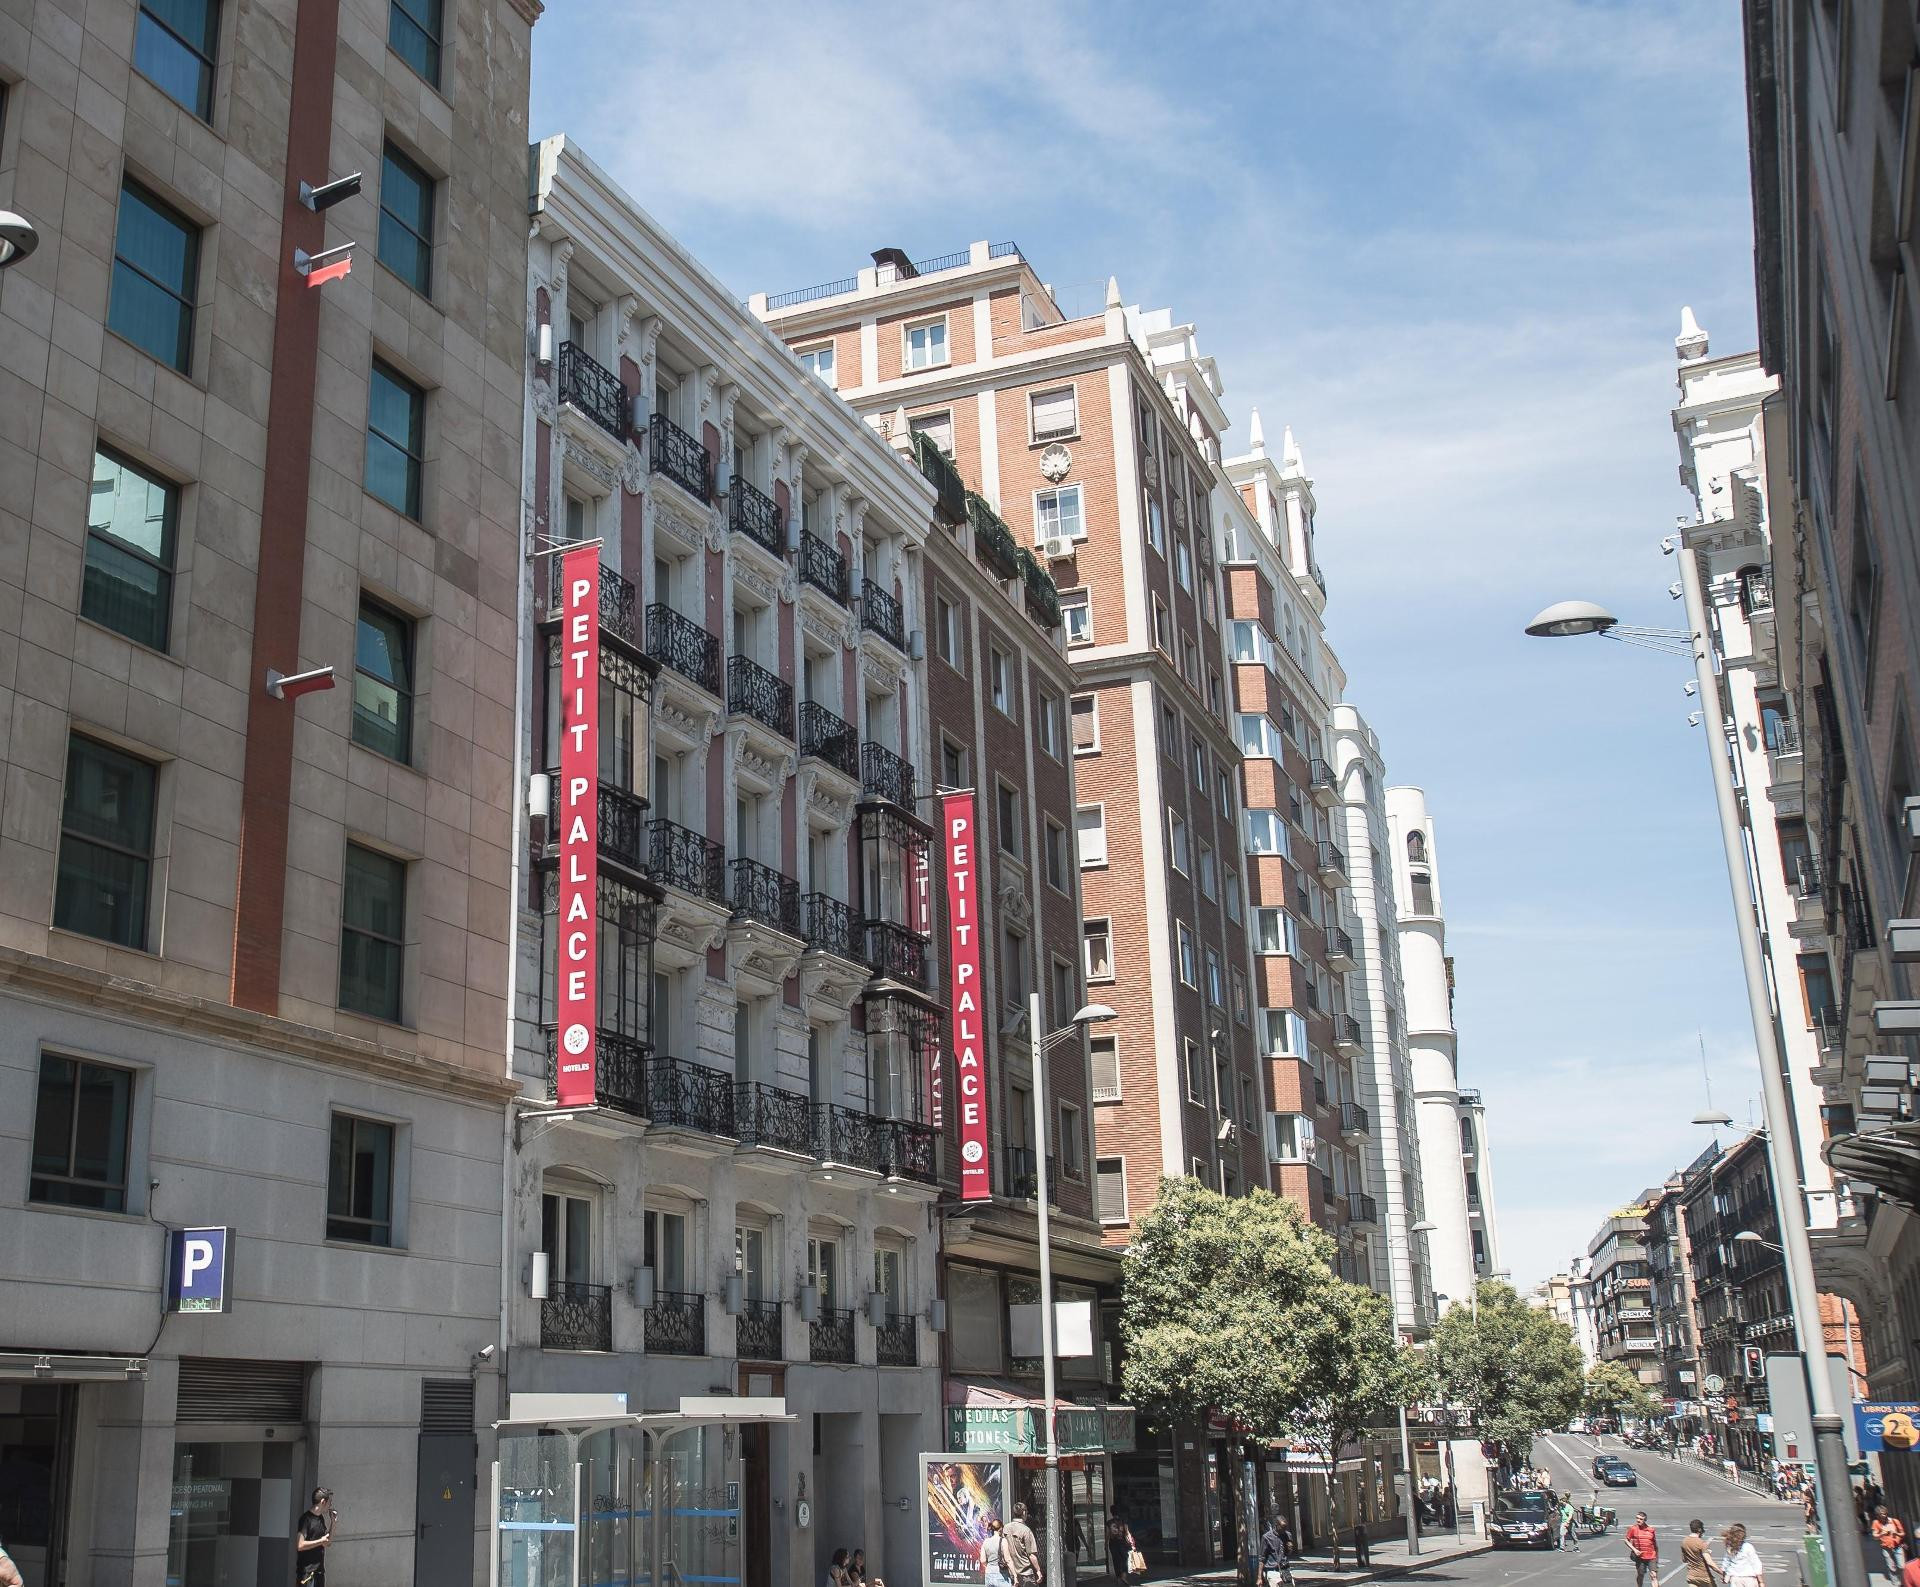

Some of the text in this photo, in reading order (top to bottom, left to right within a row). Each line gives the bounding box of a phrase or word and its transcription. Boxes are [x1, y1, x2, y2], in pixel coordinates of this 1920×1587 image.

[571, 579, 591, 753] PETIT
[567, 777, 589, 1001] PALACE
[952, 818, 971, 946] PETIT
[958, 963, 979, 1125] PALACE
[562, 1063, 590, 1073] HOTELES
[183, 1240, 213, 1287] P
[954, 1409, 1009, 1423] MEDIAS
[1860, 1405, 1893, 1413] LIBROS
[954, 1430, 1010, 1443] BOTONES
